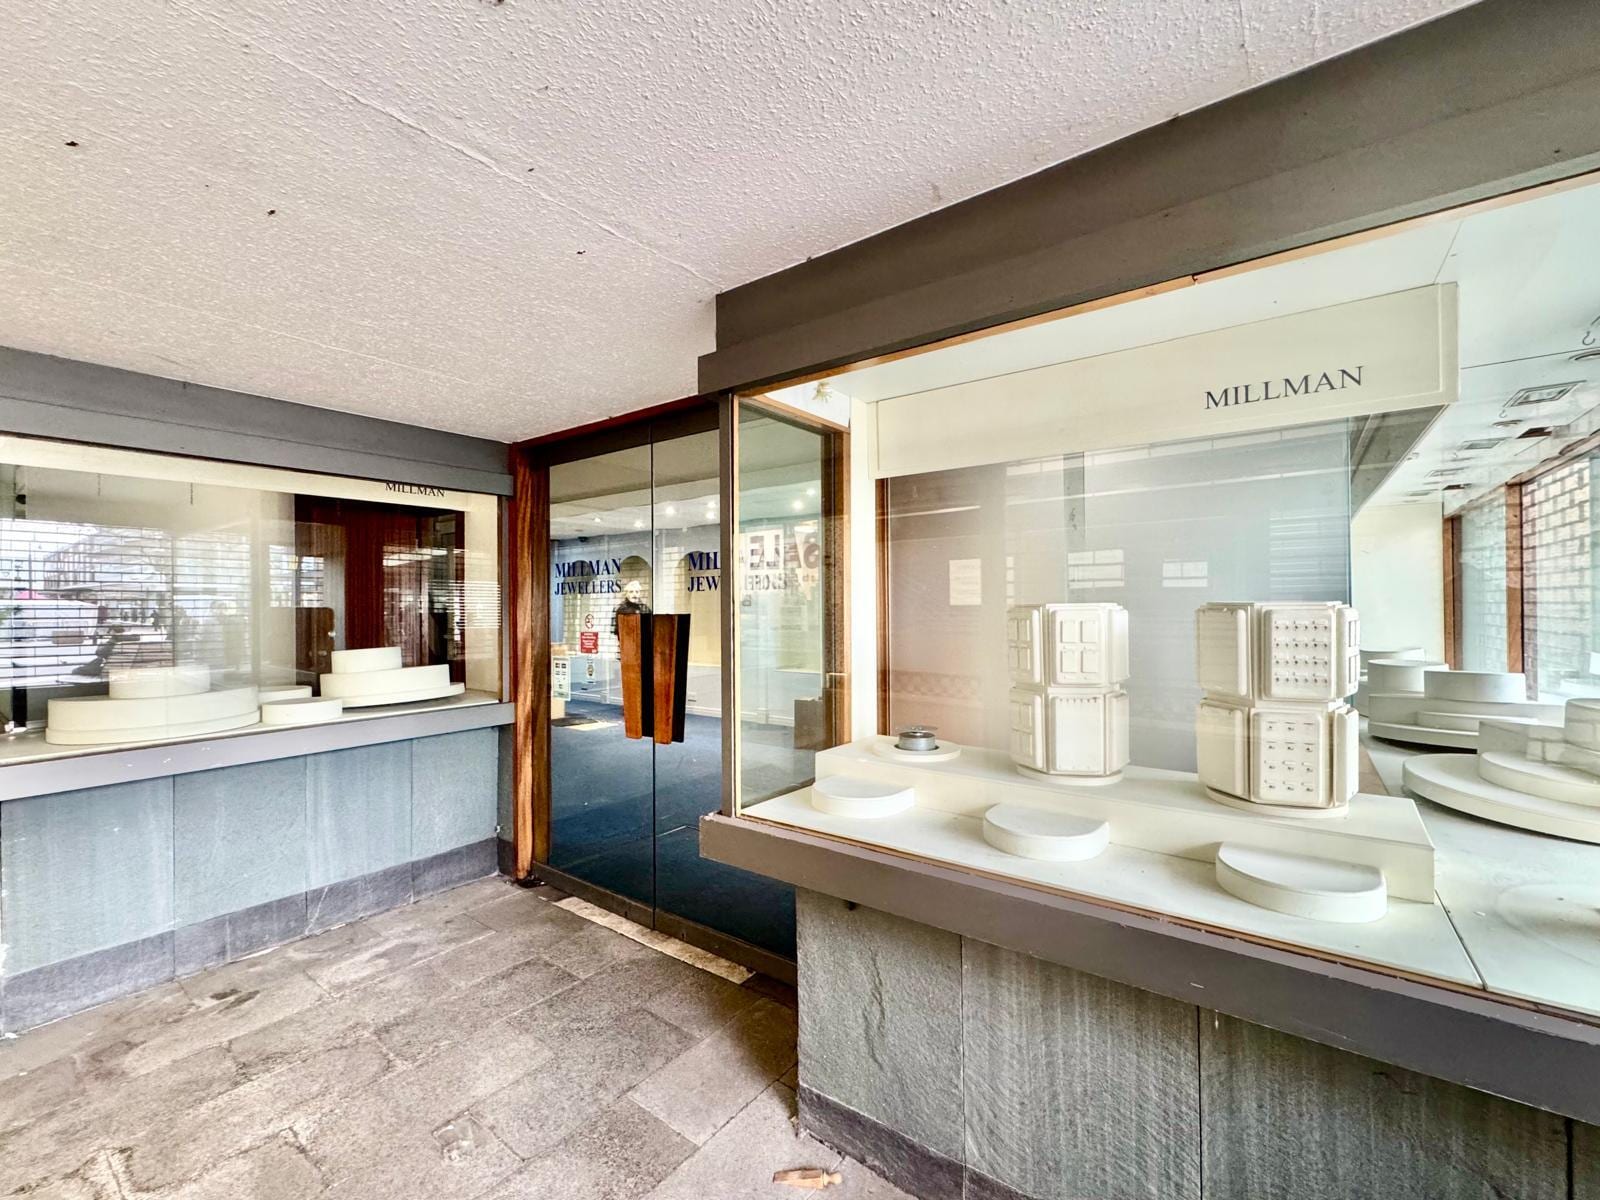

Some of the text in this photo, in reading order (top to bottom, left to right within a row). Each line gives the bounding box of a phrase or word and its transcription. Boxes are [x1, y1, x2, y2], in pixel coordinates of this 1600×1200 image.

[1204, 365, 1364, 410] MILLMAN
[385, 481, 446, 497] MILLMAN
[555, 558, 622, 578] MILLMAN
[555, 579, 622, 596] JEWELLERS
